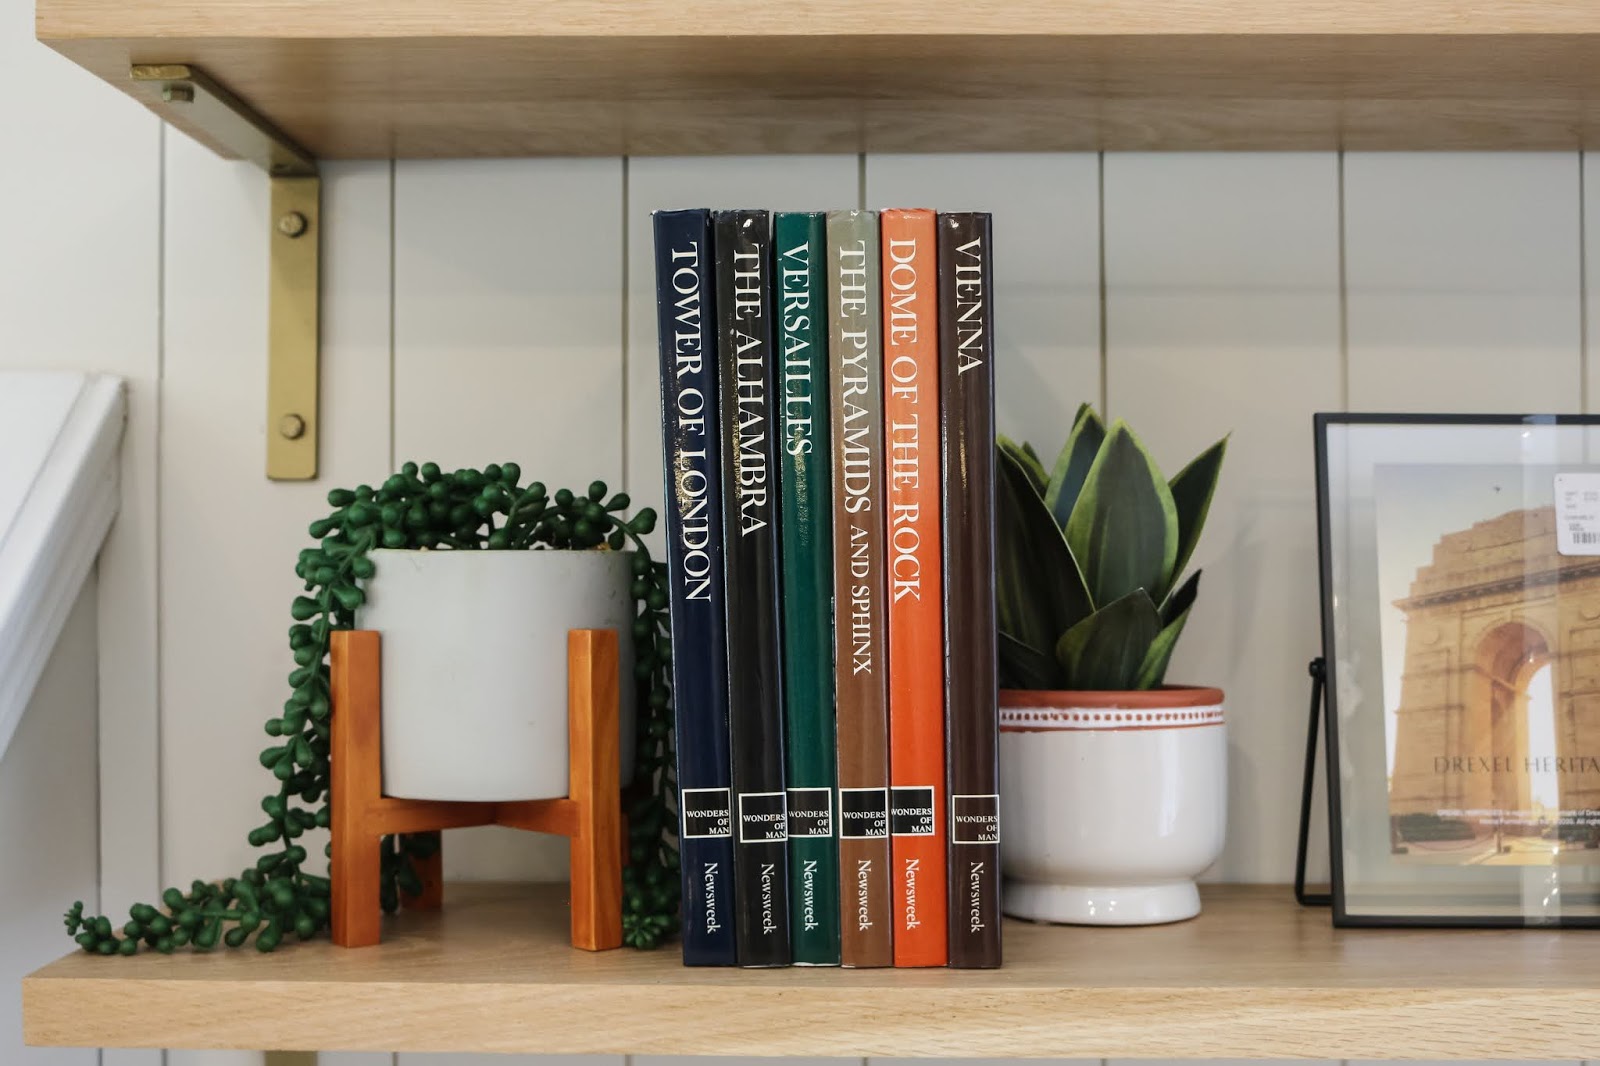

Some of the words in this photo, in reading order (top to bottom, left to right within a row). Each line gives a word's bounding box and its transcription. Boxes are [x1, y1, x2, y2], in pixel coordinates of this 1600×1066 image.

[672, 241, 703, 379] TOWER
[734, 243, 762, 321] THE
[839, 240, 867, 318] THE
[889, 238, 918, 346] DOME
[955, 236, 984, 376] VIENNA
[782, 240, 813, 456] VERSAILLES
[890, 355, 918, 404] OF
[677, 388, 706, 436] OF
[736, 329, 768, 537] ALHAMBRA
[841, 328, 872, 514] PYRAMIDS
[892, 413, 919, 490] THE
[680, 448, 712, 602] LONDON
[850, 524, 871, 579] AND
[893, 502, 921, 604] ROCK
[851, 585, 872, 676] SPHINX
[1434, 756, 1512, 773] DREXEL
[686, 809, 729, 818] WONDERS
[709, 827, 729, 835] MAN
[717, 818, 729, 826] OF
[743, 813, 786, 822] WONDERS
[765, 831, 786, 839] MAN
[774, 822, 786, 830] OF
[788, 810, 829, 818] WONDERS
[809, 827, 829, 835] MAN
[843, 811, 886, 819] WONDERS
[865, 828, 886, 836] MAN
[891, 808, 932, 816] WONDERS
[911, 825, 932, 833] MAN
[956, 815, 998, 823] WONDERS
[705, 862, 721, 935] Newsweek
[761, 863, 777, 935] Newsweek
[803, 859, 819, 932] Newsweek
[858, 859, 873, 931] Newsweek
[905, 858, 920, 931] Newsweek
[970, 861, 985, 933] Newsweek
